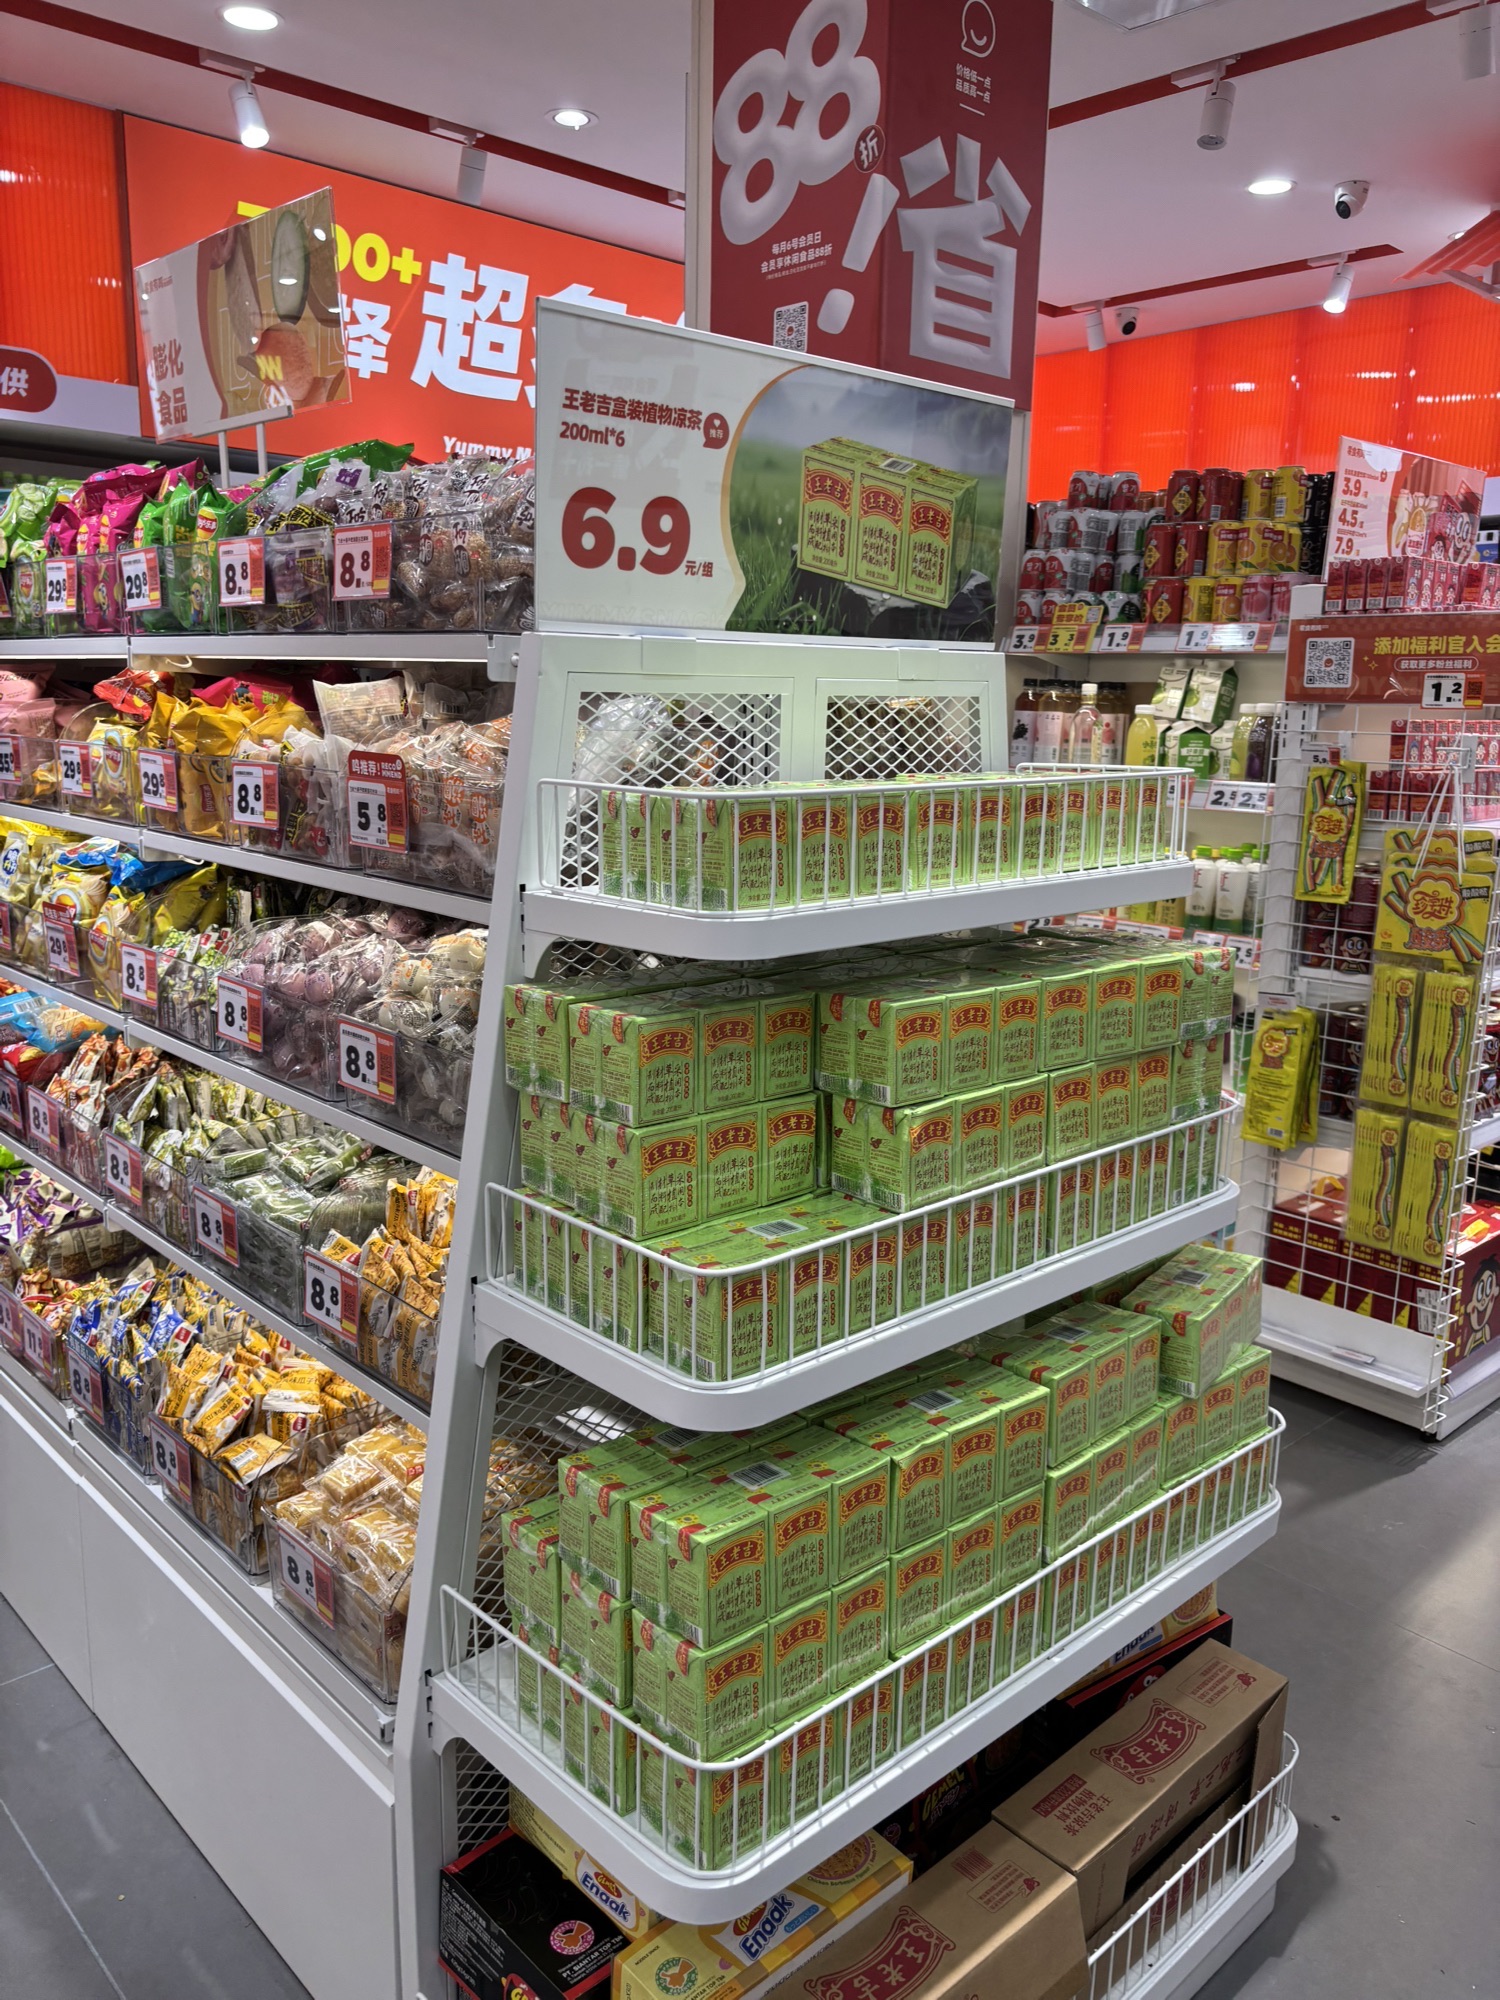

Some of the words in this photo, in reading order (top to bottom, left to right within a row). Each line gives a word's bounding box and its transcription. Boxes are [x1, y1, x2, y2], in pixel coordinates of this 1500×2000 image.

[956, 63, 991, 89] 价格低一点
[956, 78, 990, 103] 品质高一点
[713, 0, 881, 246] 88
[858, 129, 881, 170] 折
[772, 231, 821, 255] 每月6号会员日
[761, 243, 832, 273] 会员享休闲食品88折
[897, 133, 1032, 380] 省
[157, 387, 188, 427] 食品
[562, 388, 703, 431] 王老吉盒装植物凉茶
[709, 429, 724, 440] 推荐
[814, 477, 843, 498] 王老吉
[1342, 478, 1362, 498] 3.9
[869, 494, 896, 514] 王老吉
[919, 509, 945, 528] 王老吉
[1338, 508, 1359, 527] 4.5
[562, 487, 691, 575] 6.9
[1335, 538, 1354, 556] 7.9
[340, 550, 371, 588] 8.8
[684, 560, 713, 578] 元/组
[1104, 980, 1128, 995] 王老吉
[1152, 974, 1174, 989] 王老吉
[1009, 1000, 1033, 1016] 王老吉
[1055, 989, 1079, 1004] 王老吉
[774, 1011, 804, 1028] 王老吉
[907, 1017, 933, 1033] 王老吉
[960, 1008, 984, 1021] 王老吉
[652, 1033, 684, 1052] 王老吉
[715, 1022, 746, 1041] 王老吉
[346, 1045, 376, 1083] 8.8
[777, 1115, 809, 1132] 王老吉
[717, 1127, 746, 1146] 王老吉
[652, 1142, 686, 1163] 王老吉
[311, 1277, 340, 1317] 8.8
[1014, 1412, 1039, 1433] 王老吉
[959, 1433, 988, 1455] 王老吉
[909, 1458, 934, 1482] 王老吉
[851, 1483, 878, 1507] 王老吉
[787, 1512, 817, 1539] 王老吉
[1009, 1505, 1035, 1528] 王老吉
[959, 1528, 987, 1552] 王老吉
[719, 1541, 753, 1570] 王老吉
[907, 1556, 935, 1581] 王老吉
[848, 1589, 876, 1616] 王老吉
[785, 1620, 817, 1648] 王老吉
[719, 1654, 752, 1680] 王老吉
[1129, 1721, 1184, 1766] 王老吉
[1054, 1788, 1097, 1821] 植物饮料
[1063, 1793, 1113, 1837] 王老吉凉茶
[580, 1871, 630, 1922] Enaak
[740, 1893, 795, 1960] Enaak
